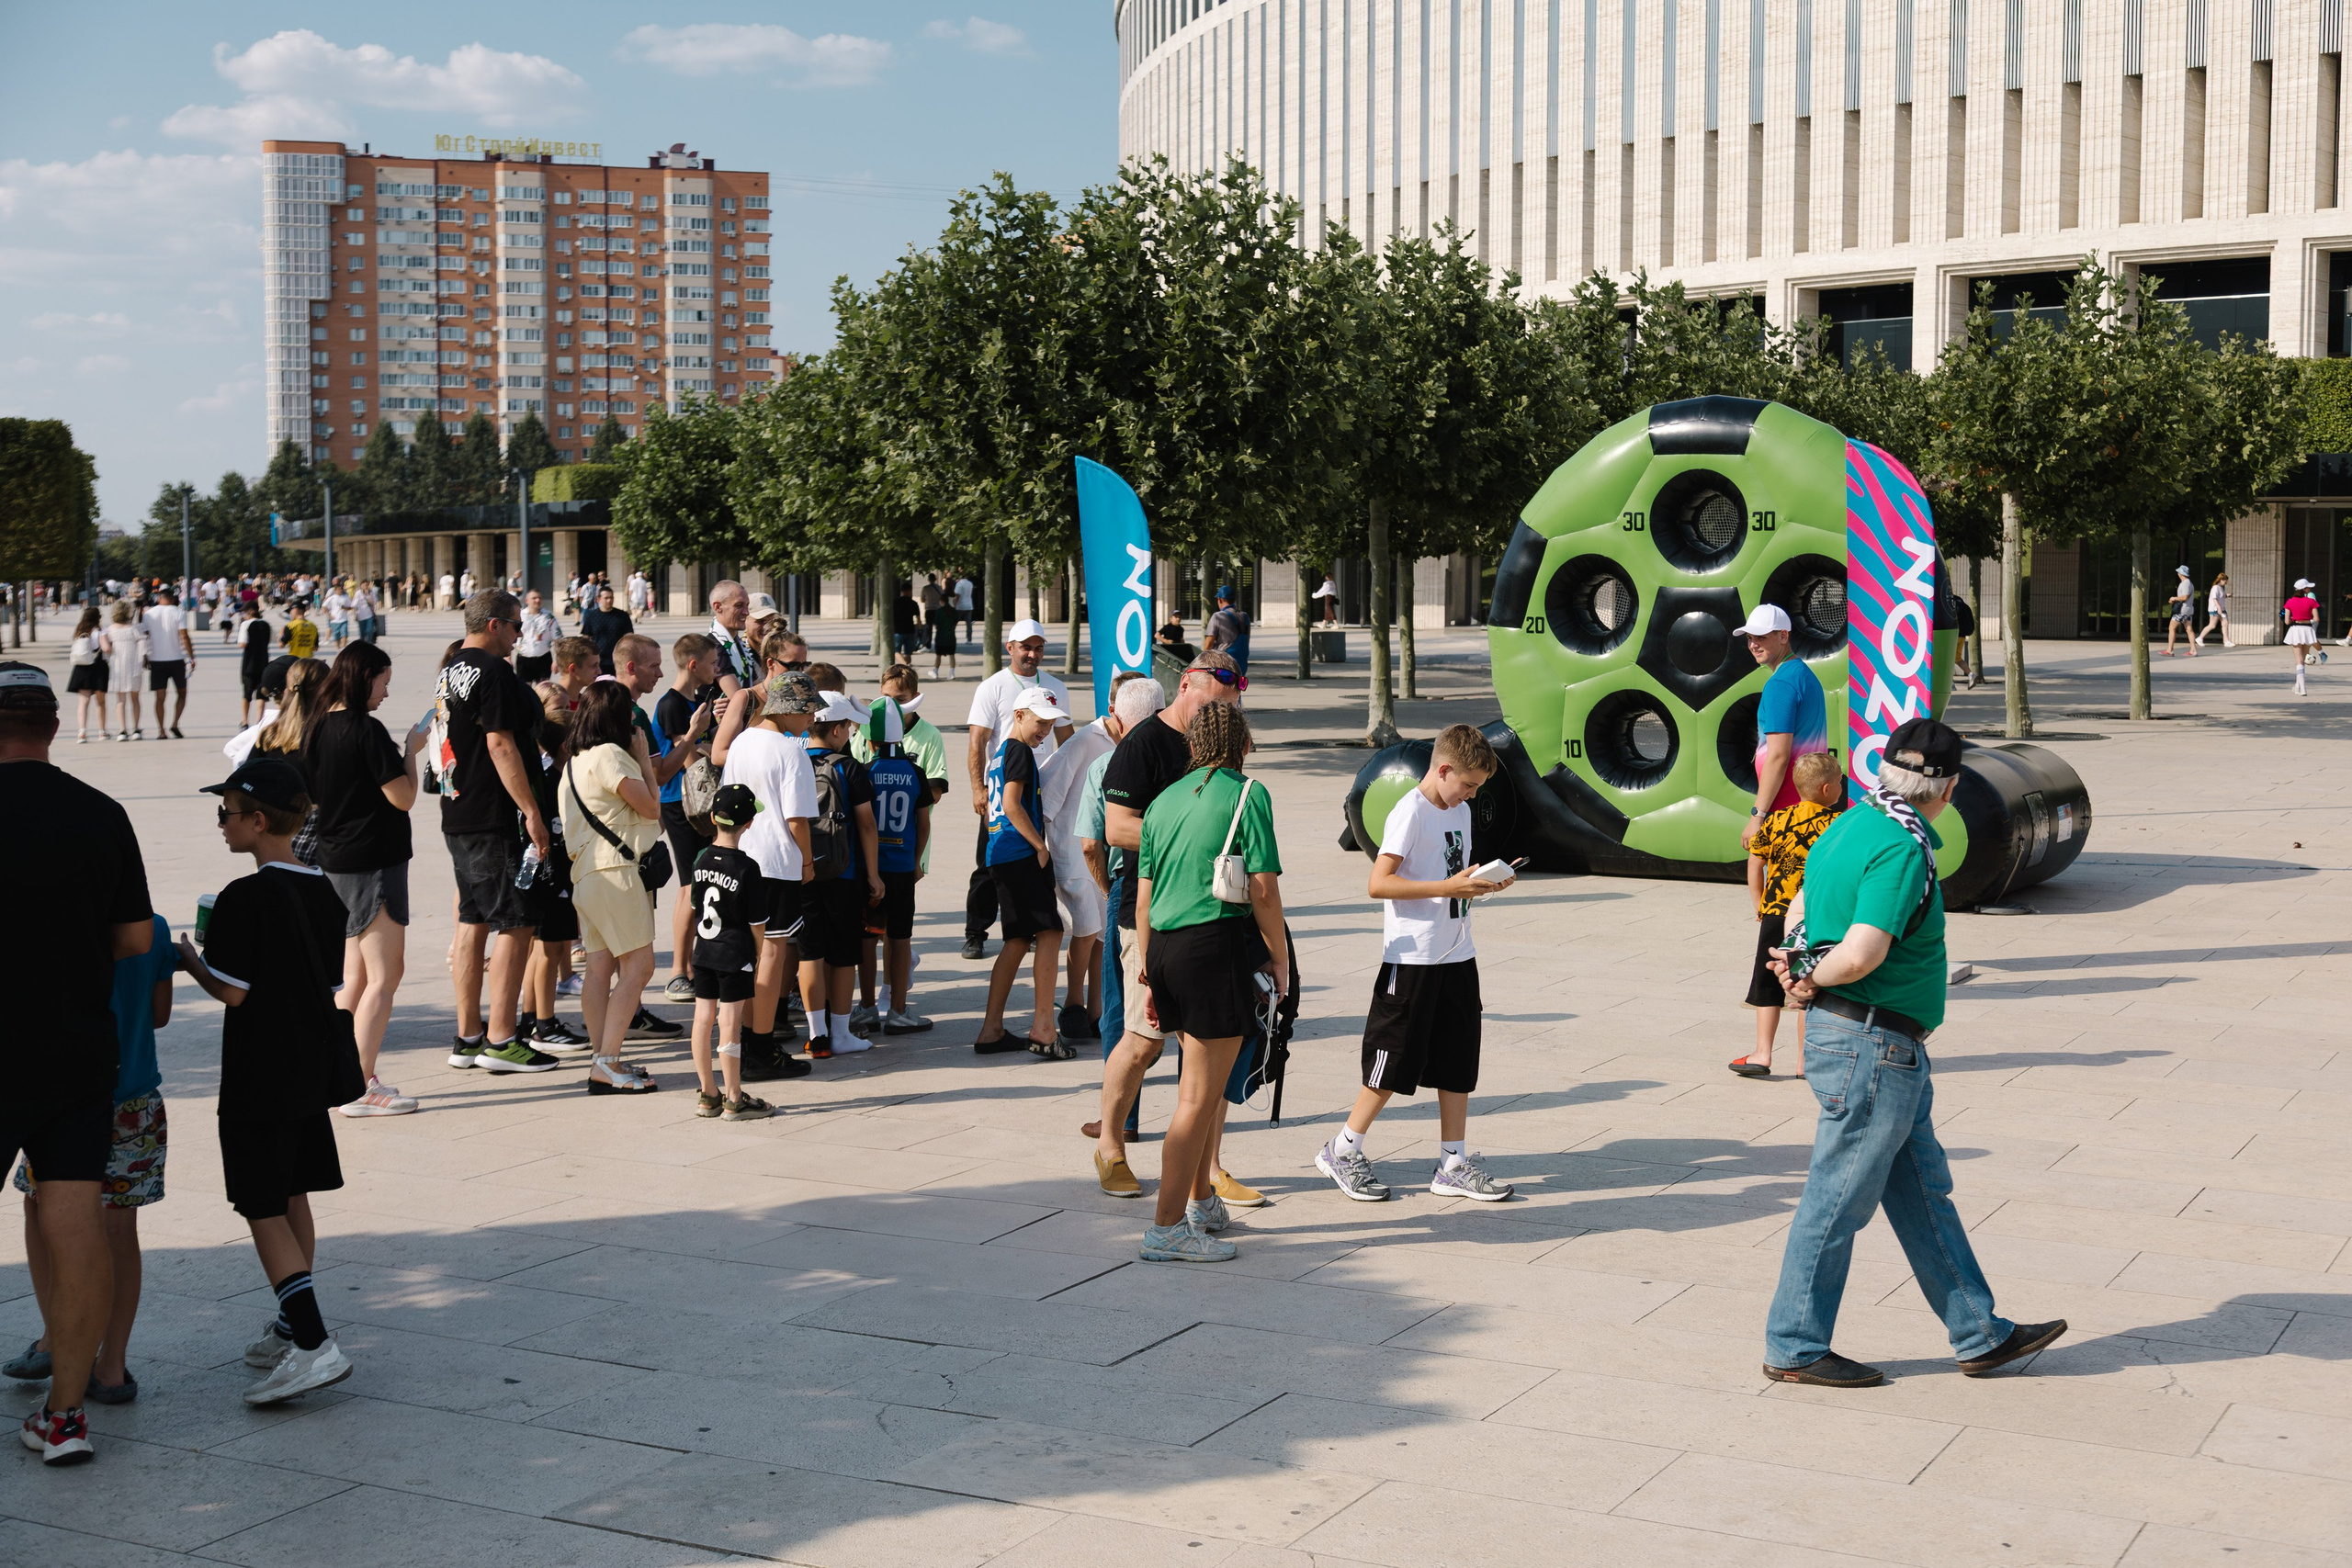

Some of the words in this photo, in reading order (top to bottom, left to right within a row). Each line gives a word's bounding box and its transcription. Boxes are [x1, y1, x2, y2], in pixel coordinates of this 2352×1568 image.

[435, 134, 600, 157] ЮгСтройИнвест
[1623, 512, 1645, 531] 30
[1752, 511, 1775, 531] 30
[1526, 616, 1544, 634] 20
[1564, 739, 1581, 758] 10
[874, 773, 912, 785] ШЕВЧУК
[876, 790, 910, 832] 19
[697, 886, 721, 940] 6
